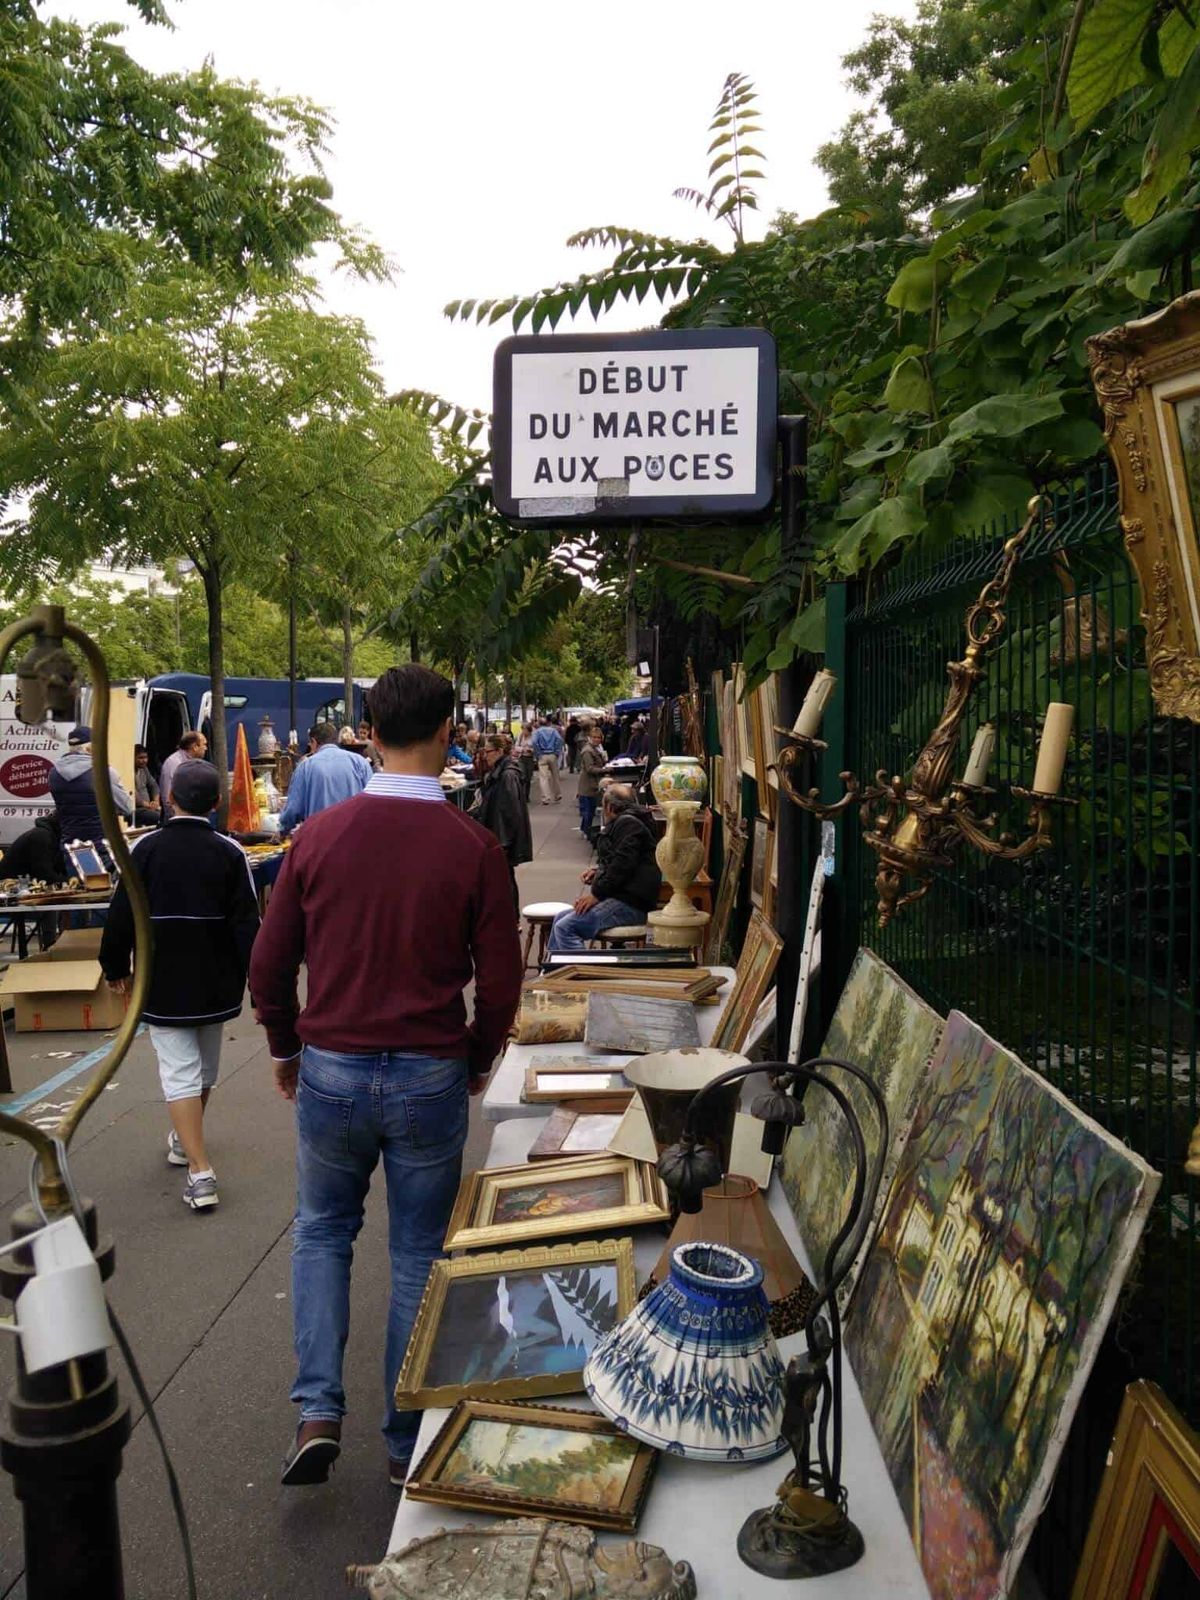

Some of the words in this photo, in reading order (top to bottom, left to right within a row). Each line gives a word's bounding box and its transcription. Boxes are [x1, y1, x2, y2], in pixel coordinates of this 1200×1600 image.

[578, 361, 688, 395] DÉBUT
[529, 413, 571, 440] DU
[593, 402, 739, 439] MARCHÉ
[533, 456, 600, 483] AUX
[623, 453, 734, 482] PUCES
[0, 740, 59, 751] domicile
[11, 760, 44, 772] Service
[9, 781, 30, 791] sous
[3, 808, 17, 817] 09
